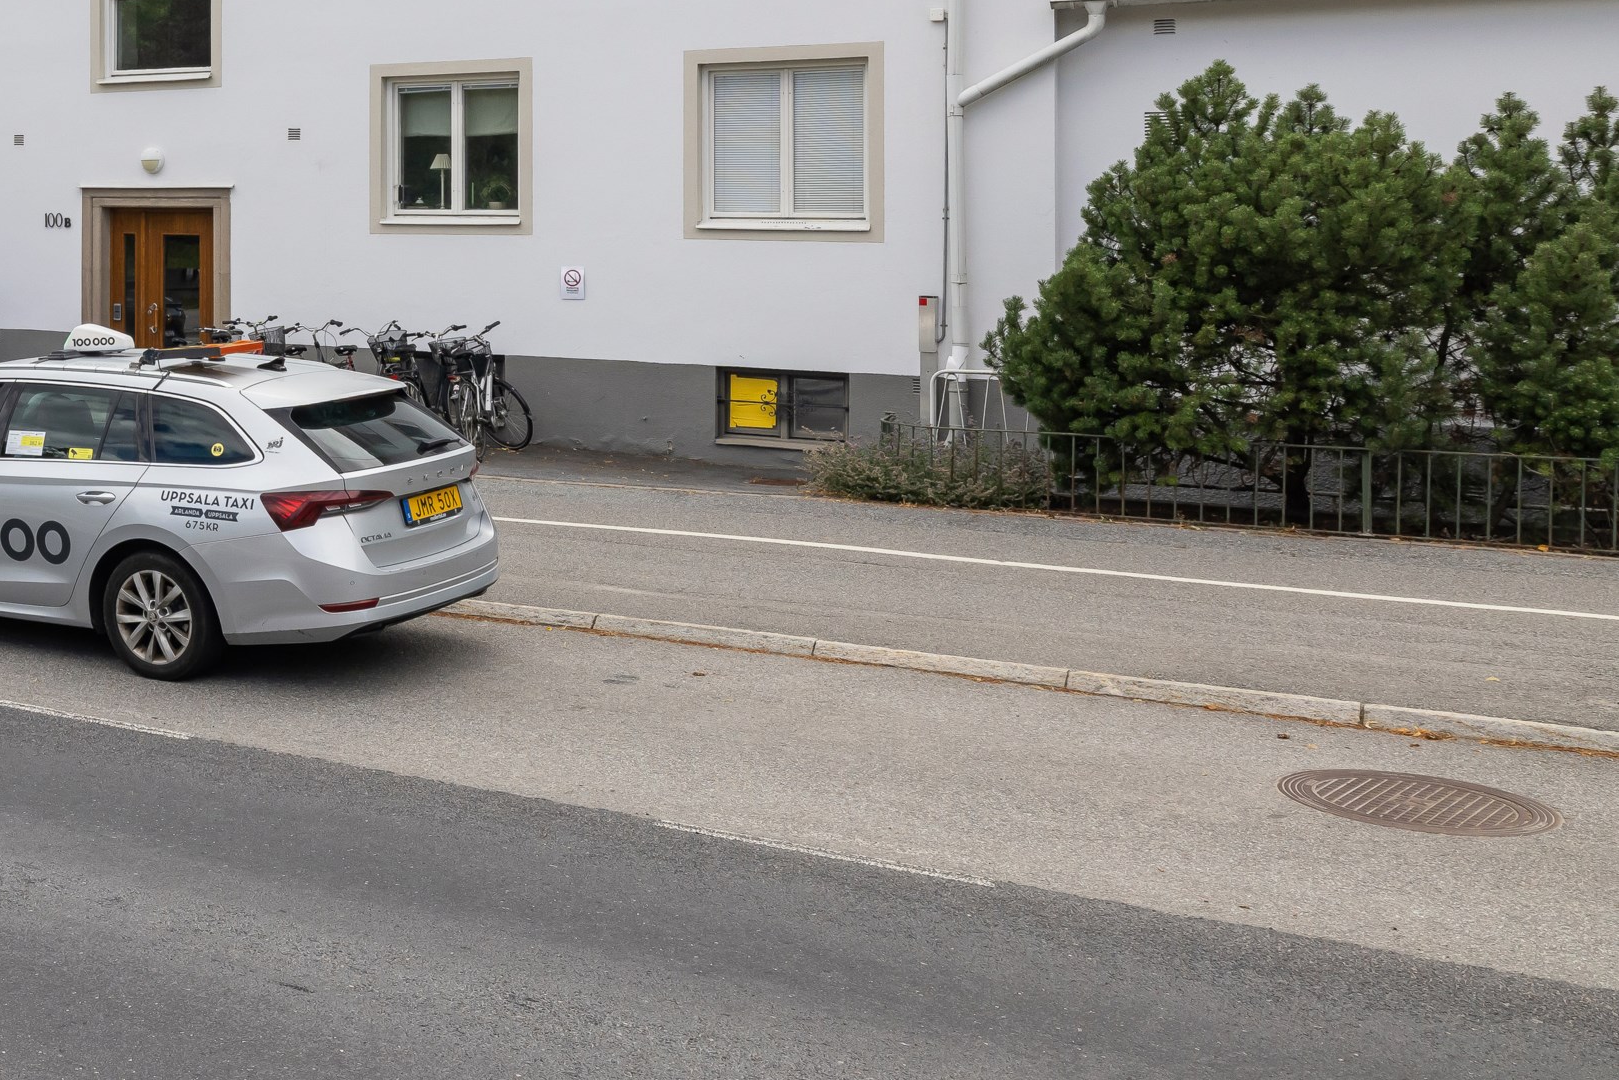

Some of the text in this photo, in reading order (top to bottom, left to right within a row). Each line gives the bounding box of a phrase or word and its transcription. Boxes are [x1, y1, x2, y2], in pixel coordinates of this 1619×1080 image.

[161, 490, 255, 510] UPPSALA TAXI
[415, 489, 458, 517] JMR 50X
[174, 508, 233, 520] ARLANDA UPPSALA
[185, 520, 219, 532] 675KR
